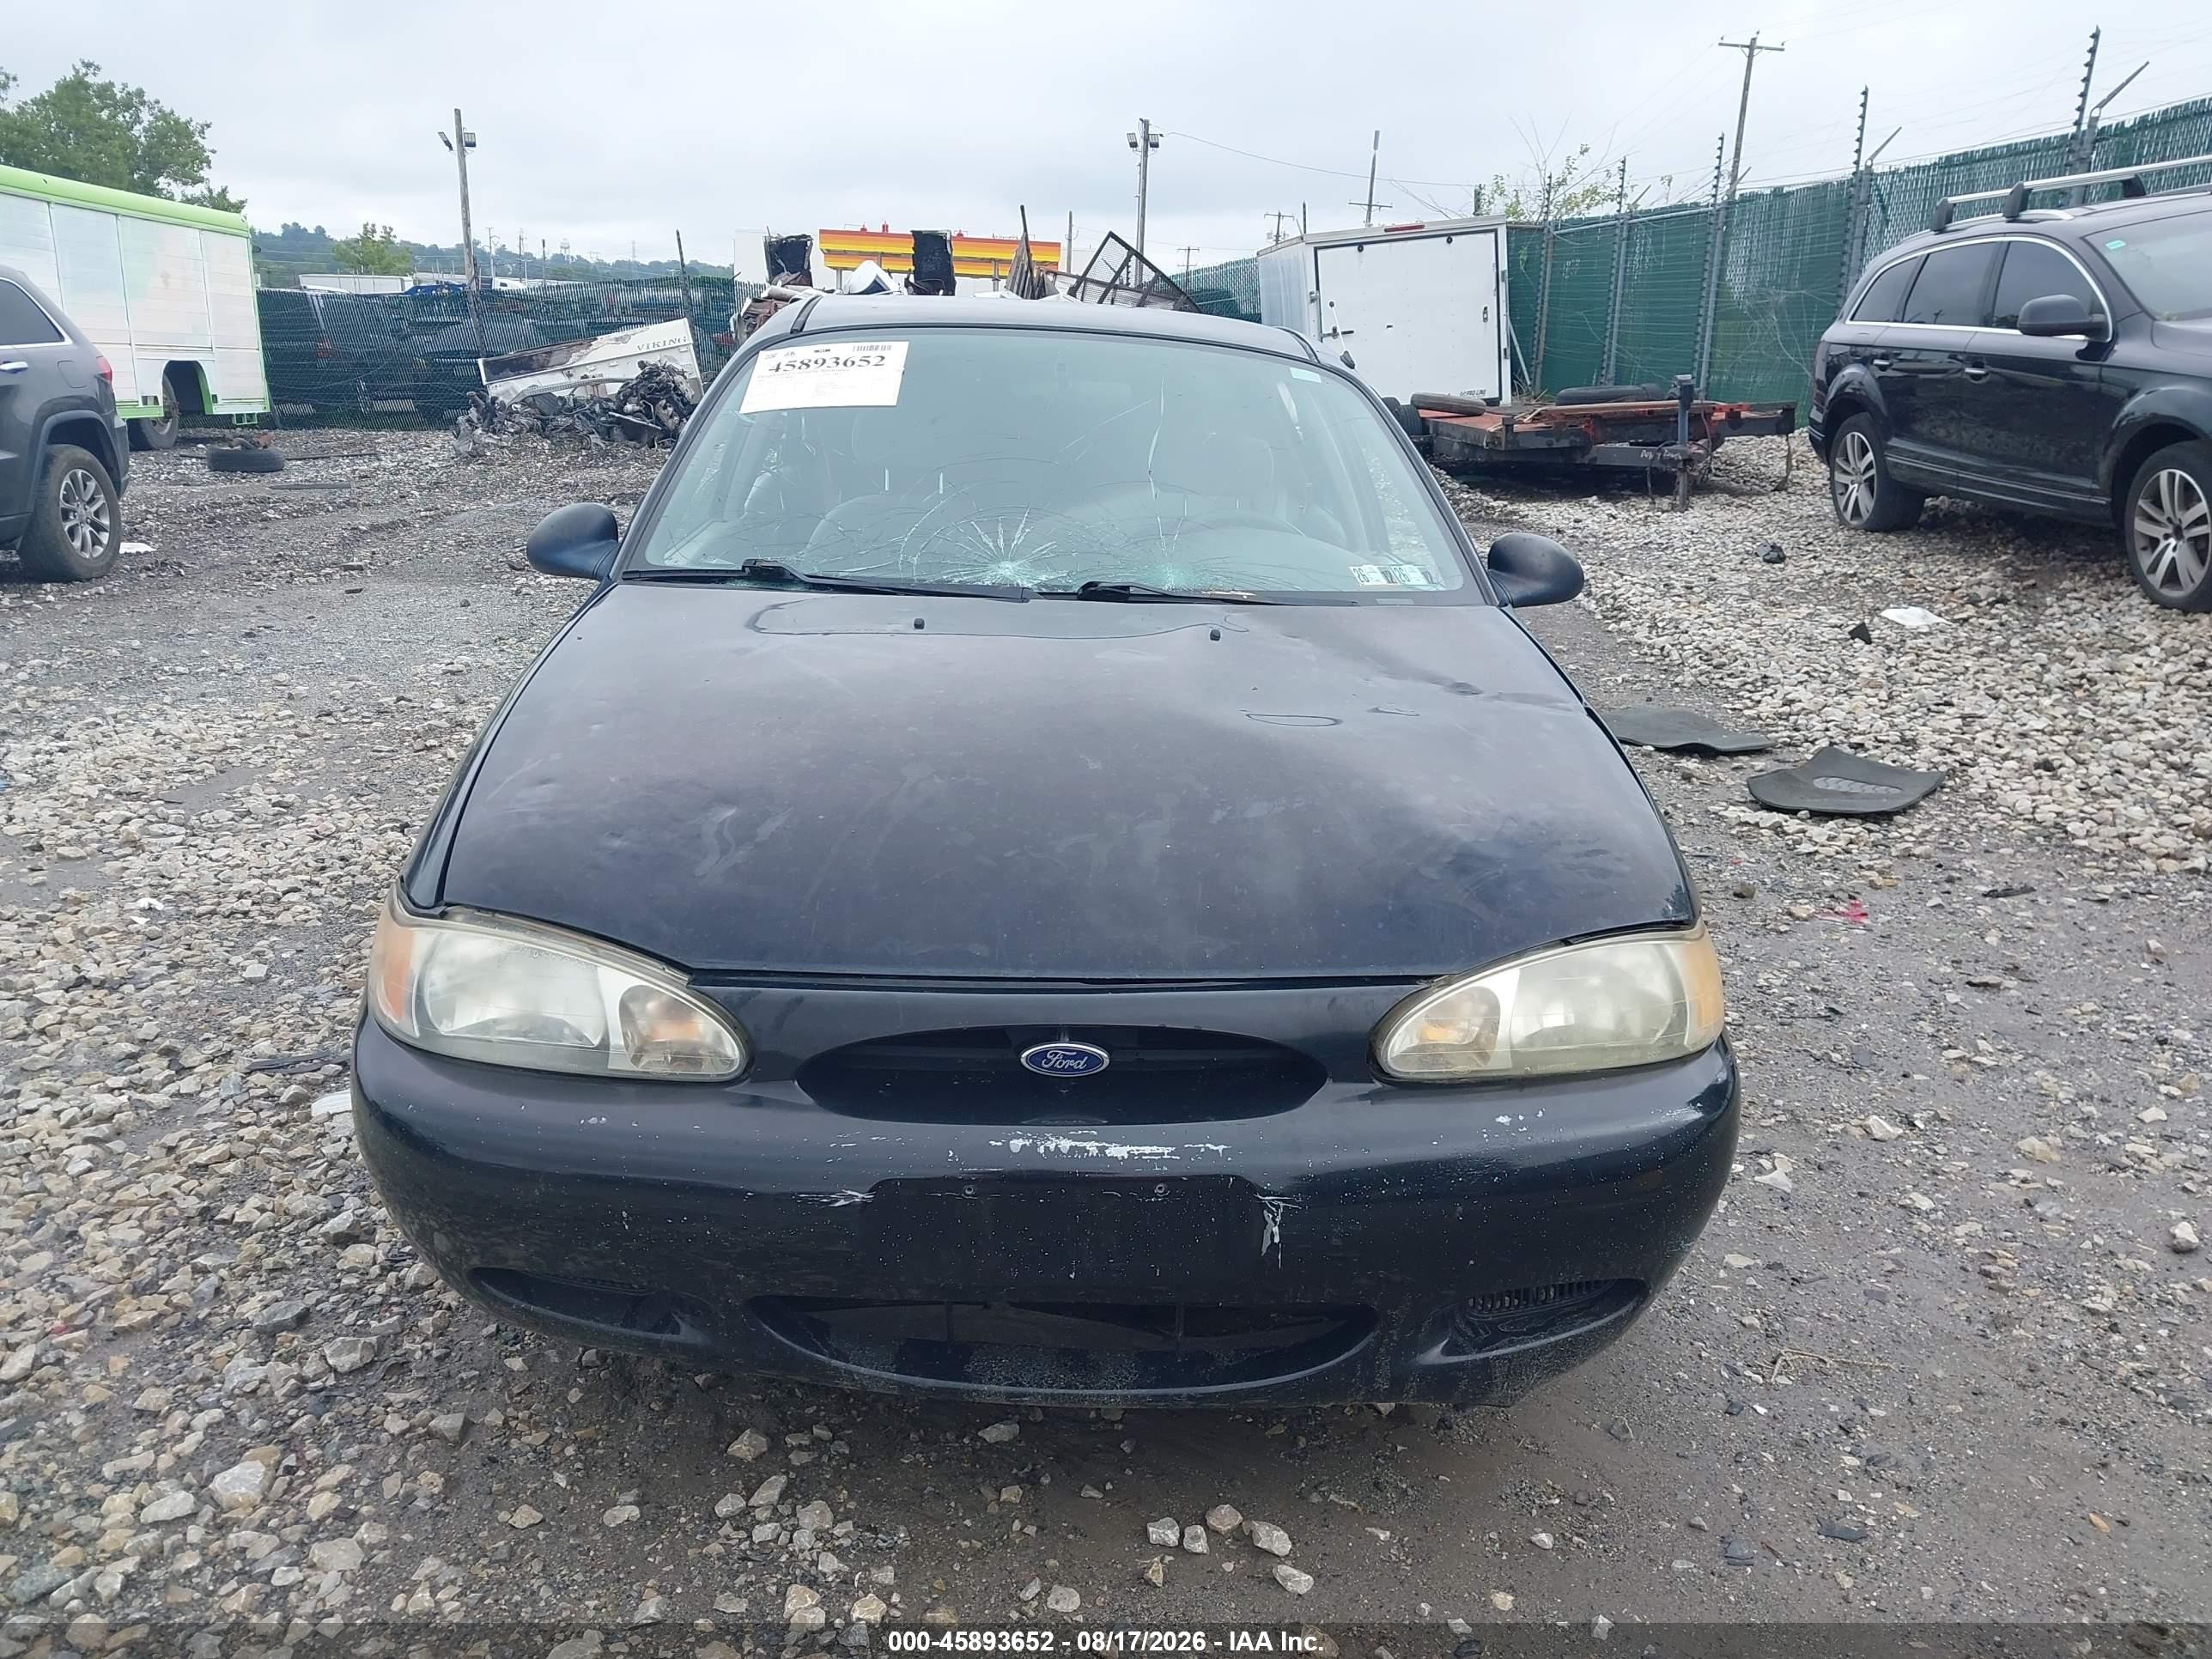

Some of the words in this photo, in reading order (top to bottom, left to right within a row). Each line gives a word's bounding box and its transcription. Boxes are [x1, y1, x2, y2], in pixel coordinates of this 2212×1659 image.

[636, 336, 687, 351] VIKING
[769, 355, 886, 373] 45893652
[1352, 568, 1370, 583] 26
[1041, 1049, 1089, 1070] Ford
